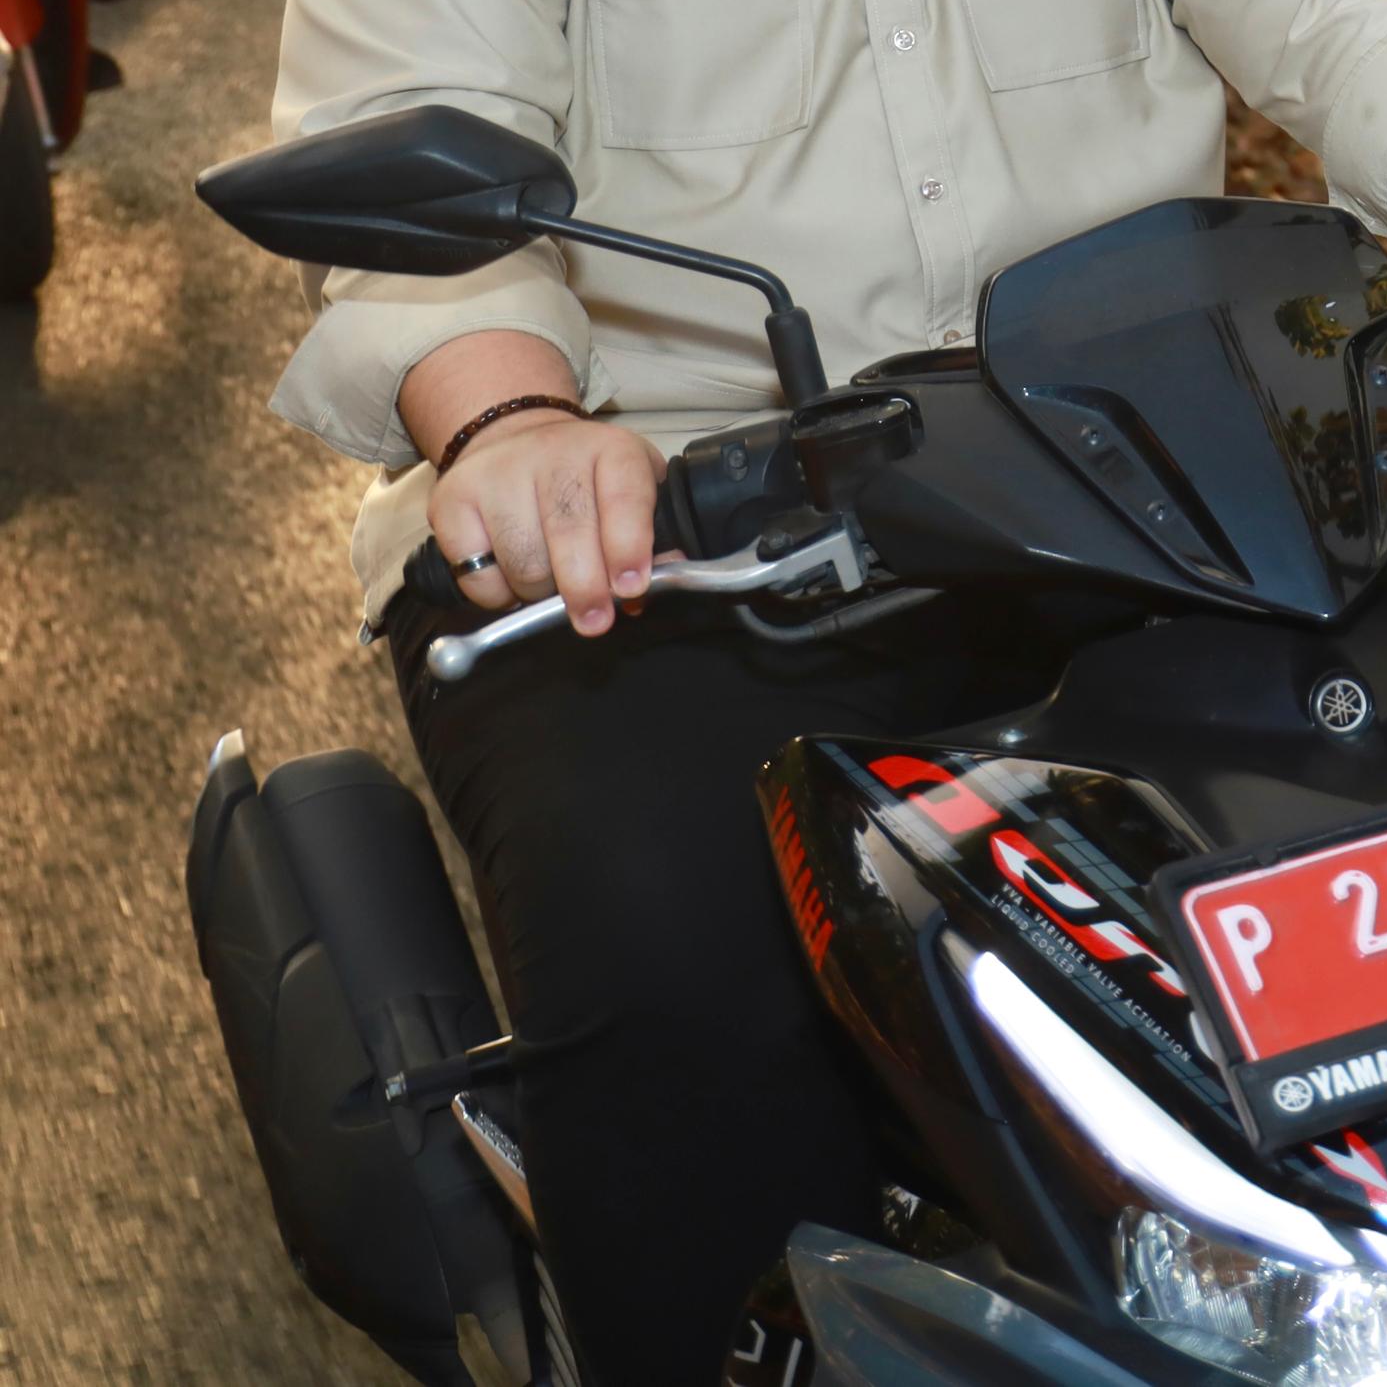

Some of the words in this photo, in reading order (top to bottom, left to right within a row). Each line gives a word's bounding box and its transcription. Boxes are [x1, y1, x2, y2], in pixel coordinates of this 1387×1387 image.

[991, 894, 1029, 932] LIQUID
[1031, 932, 1075, 974] COOLED
[1002, 883, 1022, 906] VVA
[1034, 913, 1086, 964] VARIABLE
[1087, 963, 1123, 998] VALVE
[1124, 999, 1192, 1063] ACTUATION
[1215, 903, 1273, 992] P
